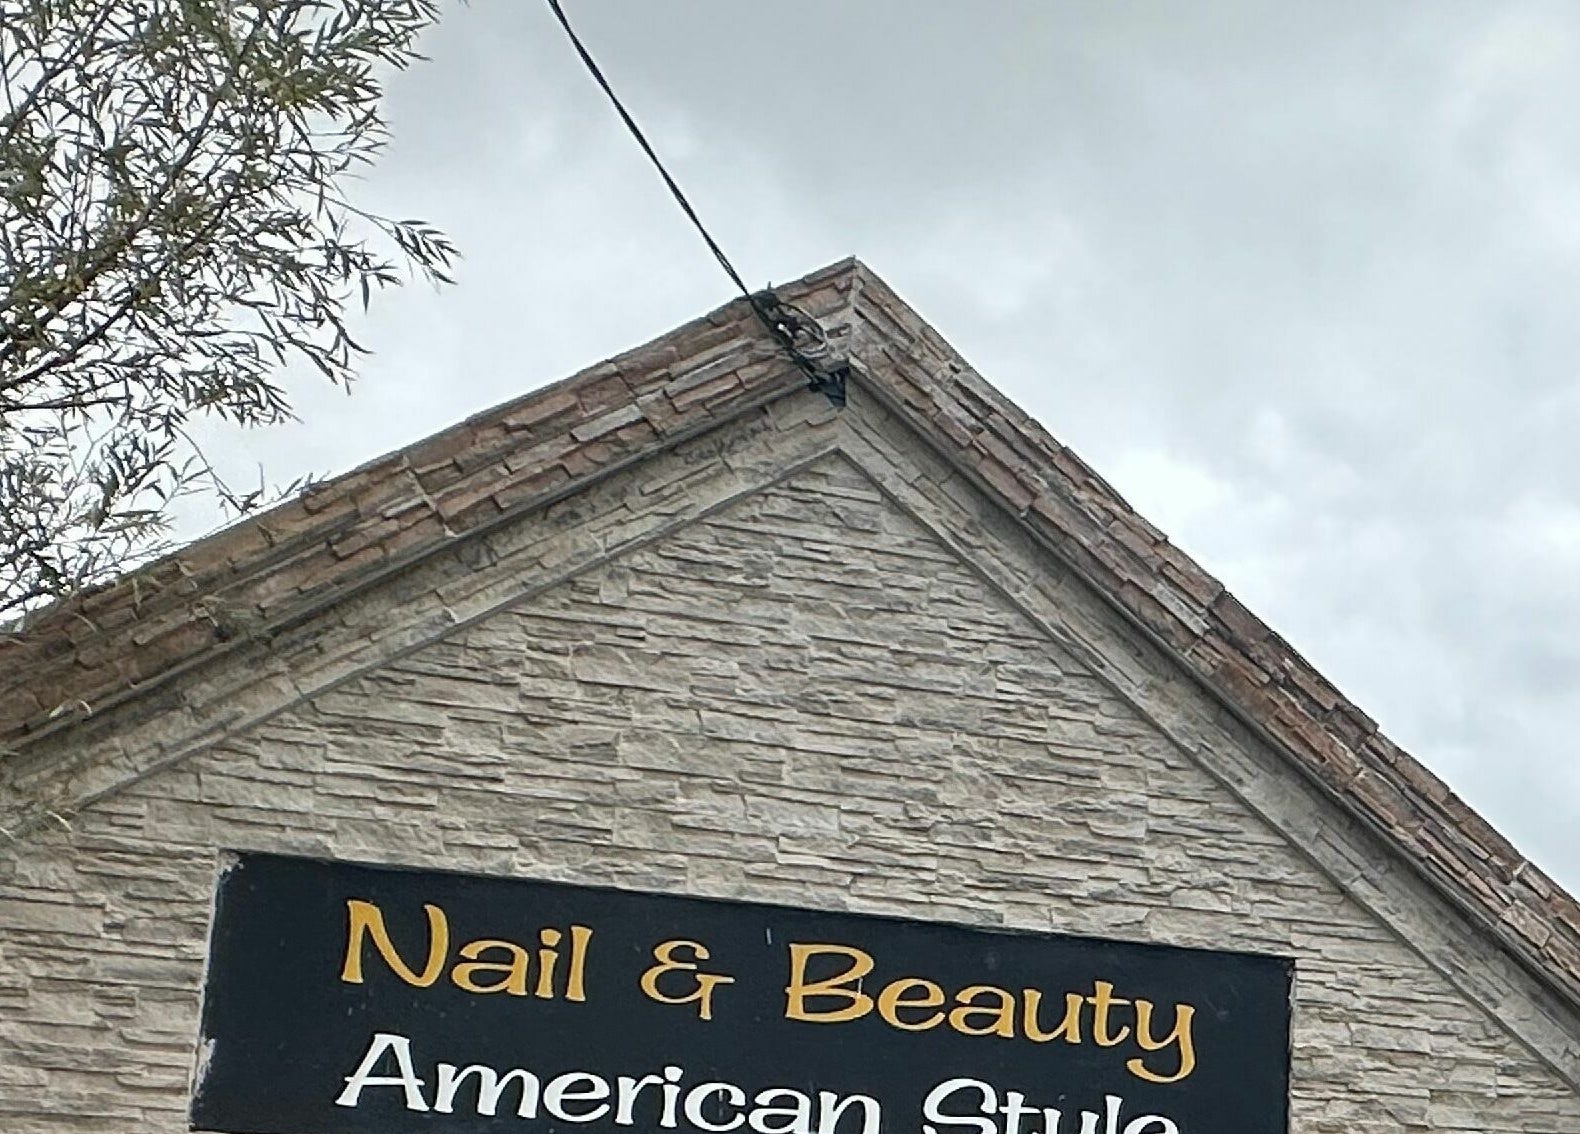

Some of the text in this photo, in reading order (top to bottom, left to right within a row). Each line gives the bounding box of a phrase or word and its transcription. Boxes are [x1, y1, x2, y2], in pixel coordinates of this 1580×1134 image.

[341, 900, 1196, 1083] Nail & Beauty
